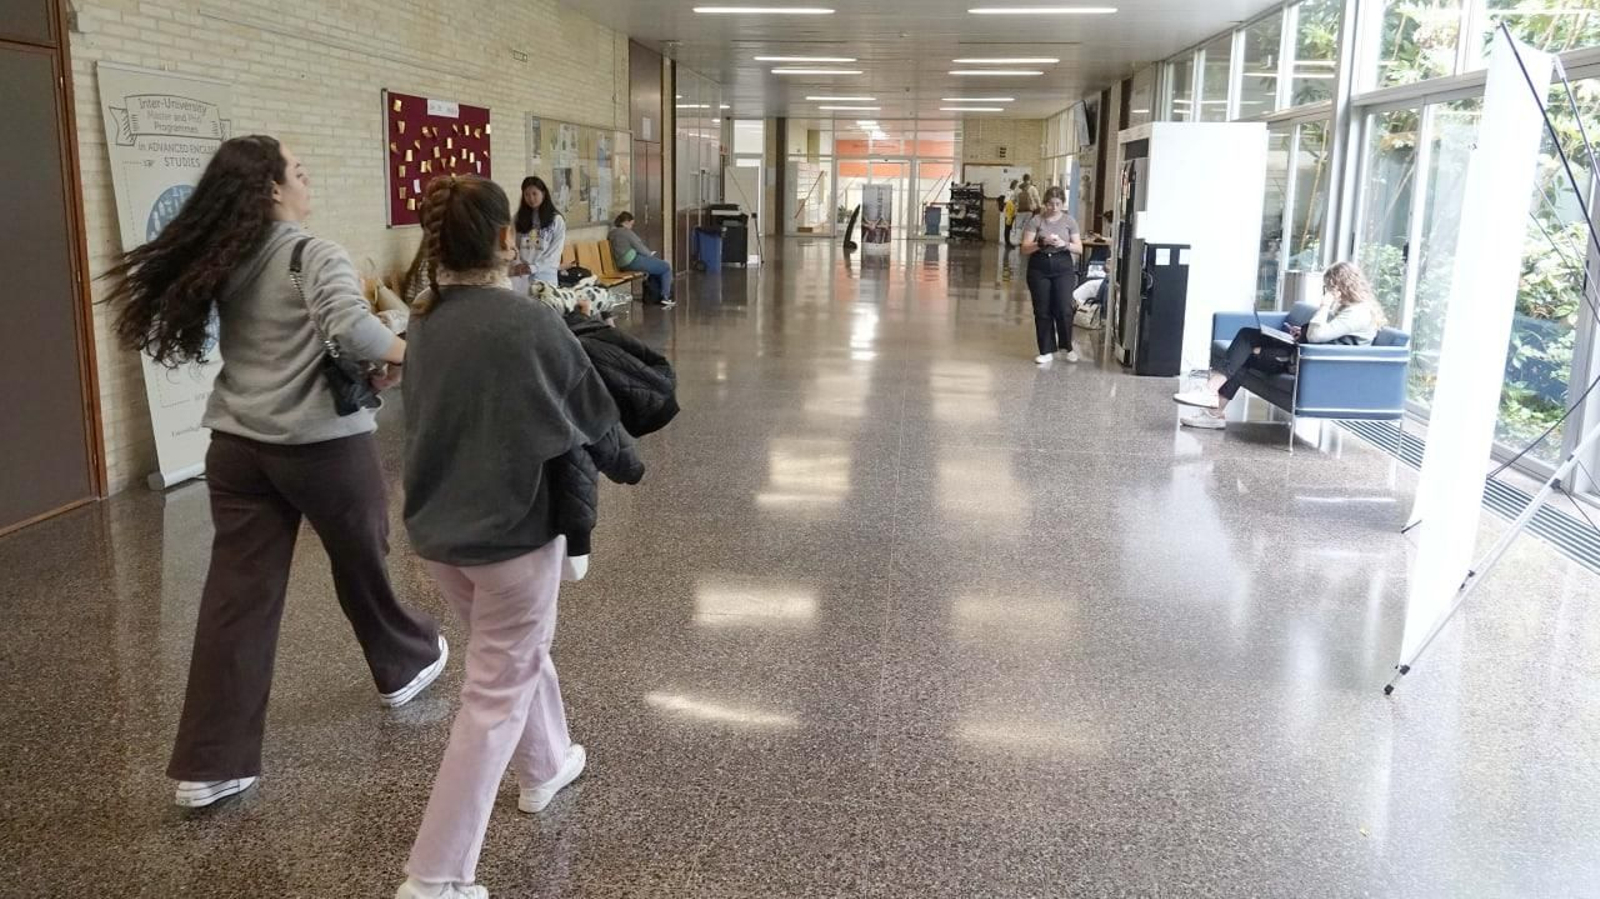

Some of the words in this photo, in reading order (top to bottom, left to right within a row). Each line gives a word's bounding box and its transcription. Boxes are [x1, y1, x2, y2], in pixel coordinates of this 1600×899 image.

[139, 98, 207, 116] Inter-University
[148, 142, 188, 153] ADVANCED
[163, 156, 201, 168] STUDIES
